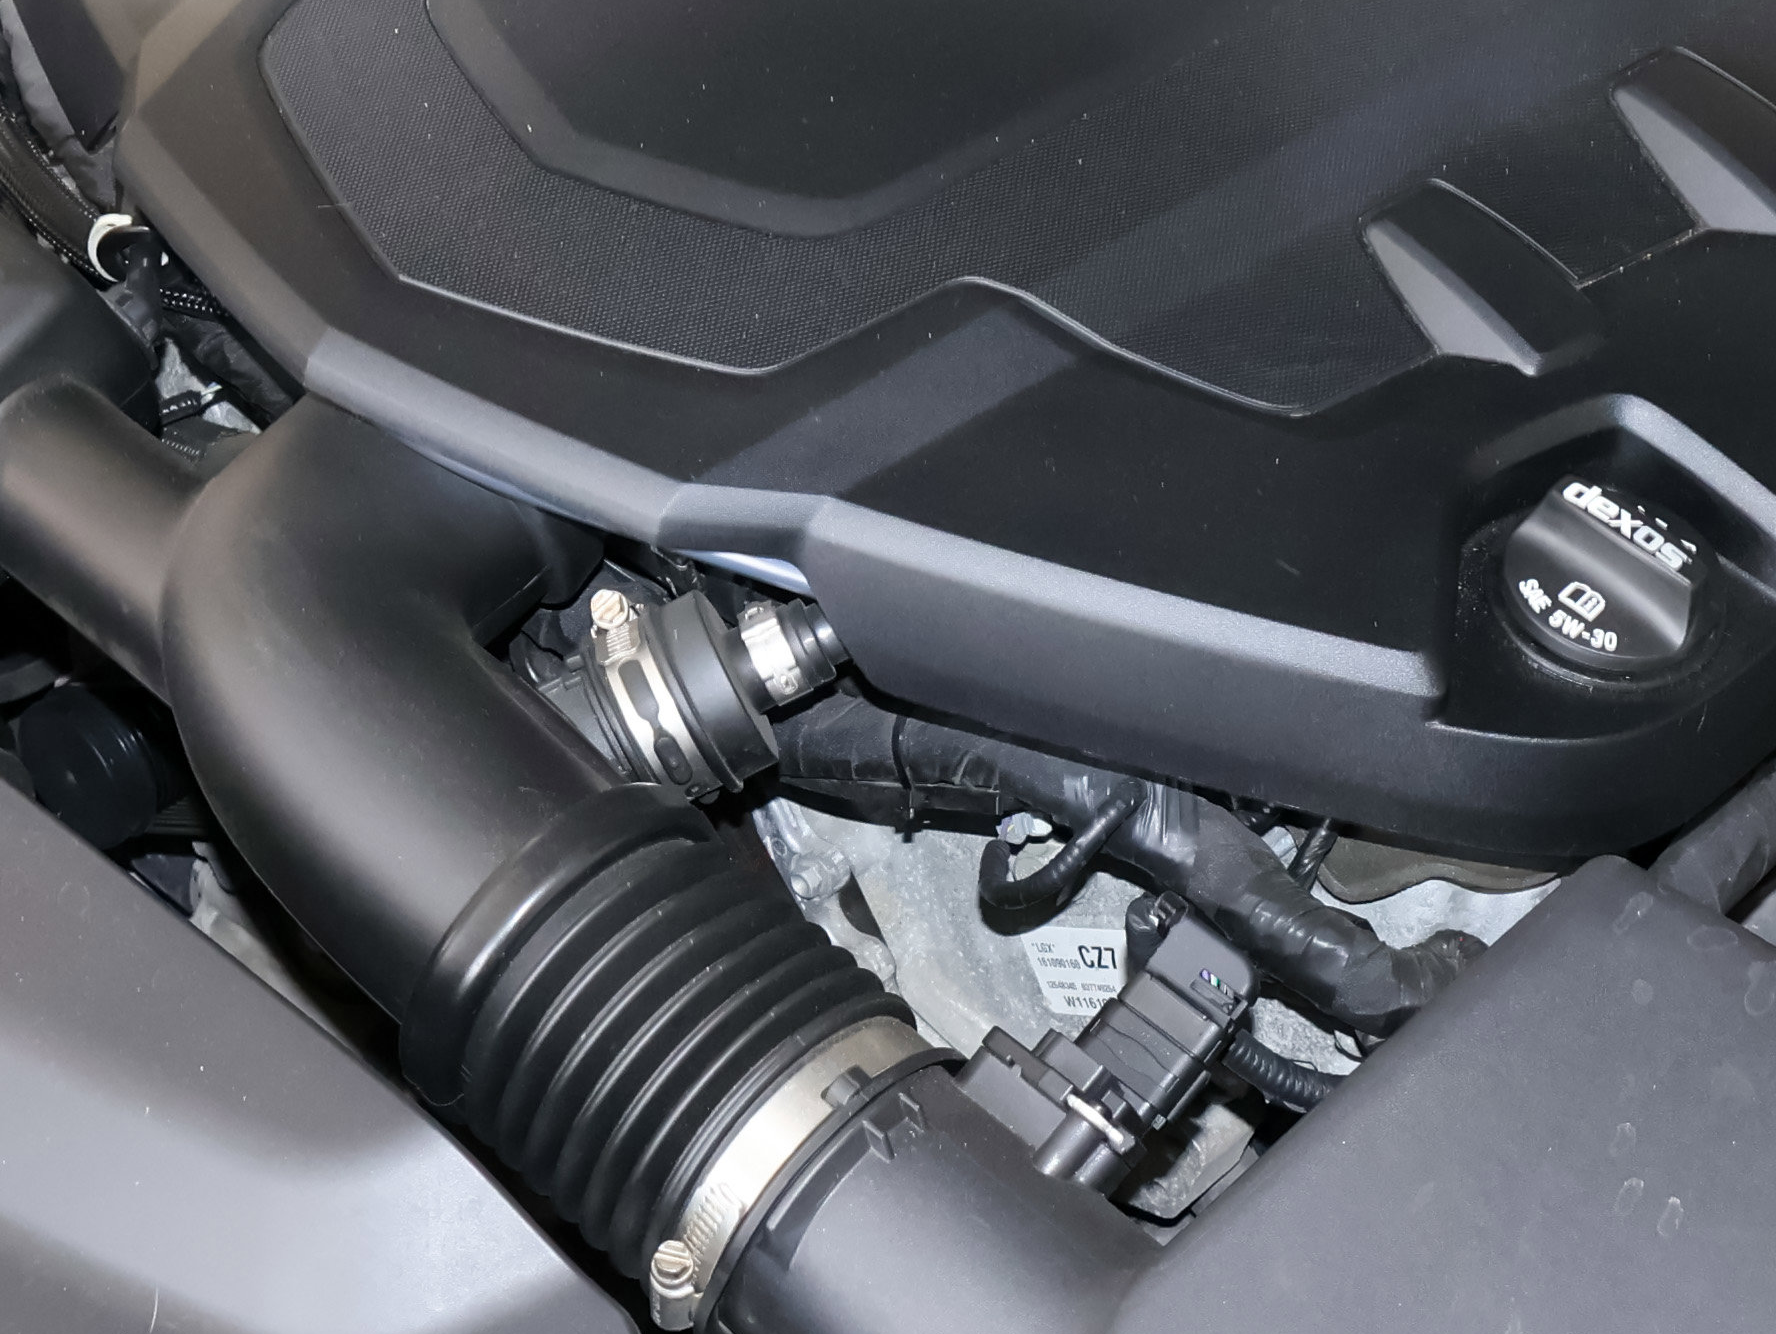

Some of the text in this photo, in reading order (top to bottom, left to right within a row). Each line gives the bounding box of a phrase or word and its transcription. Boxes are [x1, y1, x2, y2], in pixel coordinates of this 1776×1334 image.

[1562, 481, 1688, 572] dexos
[1518, 577, 1619, 652] SAE 5W-30
[1077, 944, 1118, 970] CZ7
